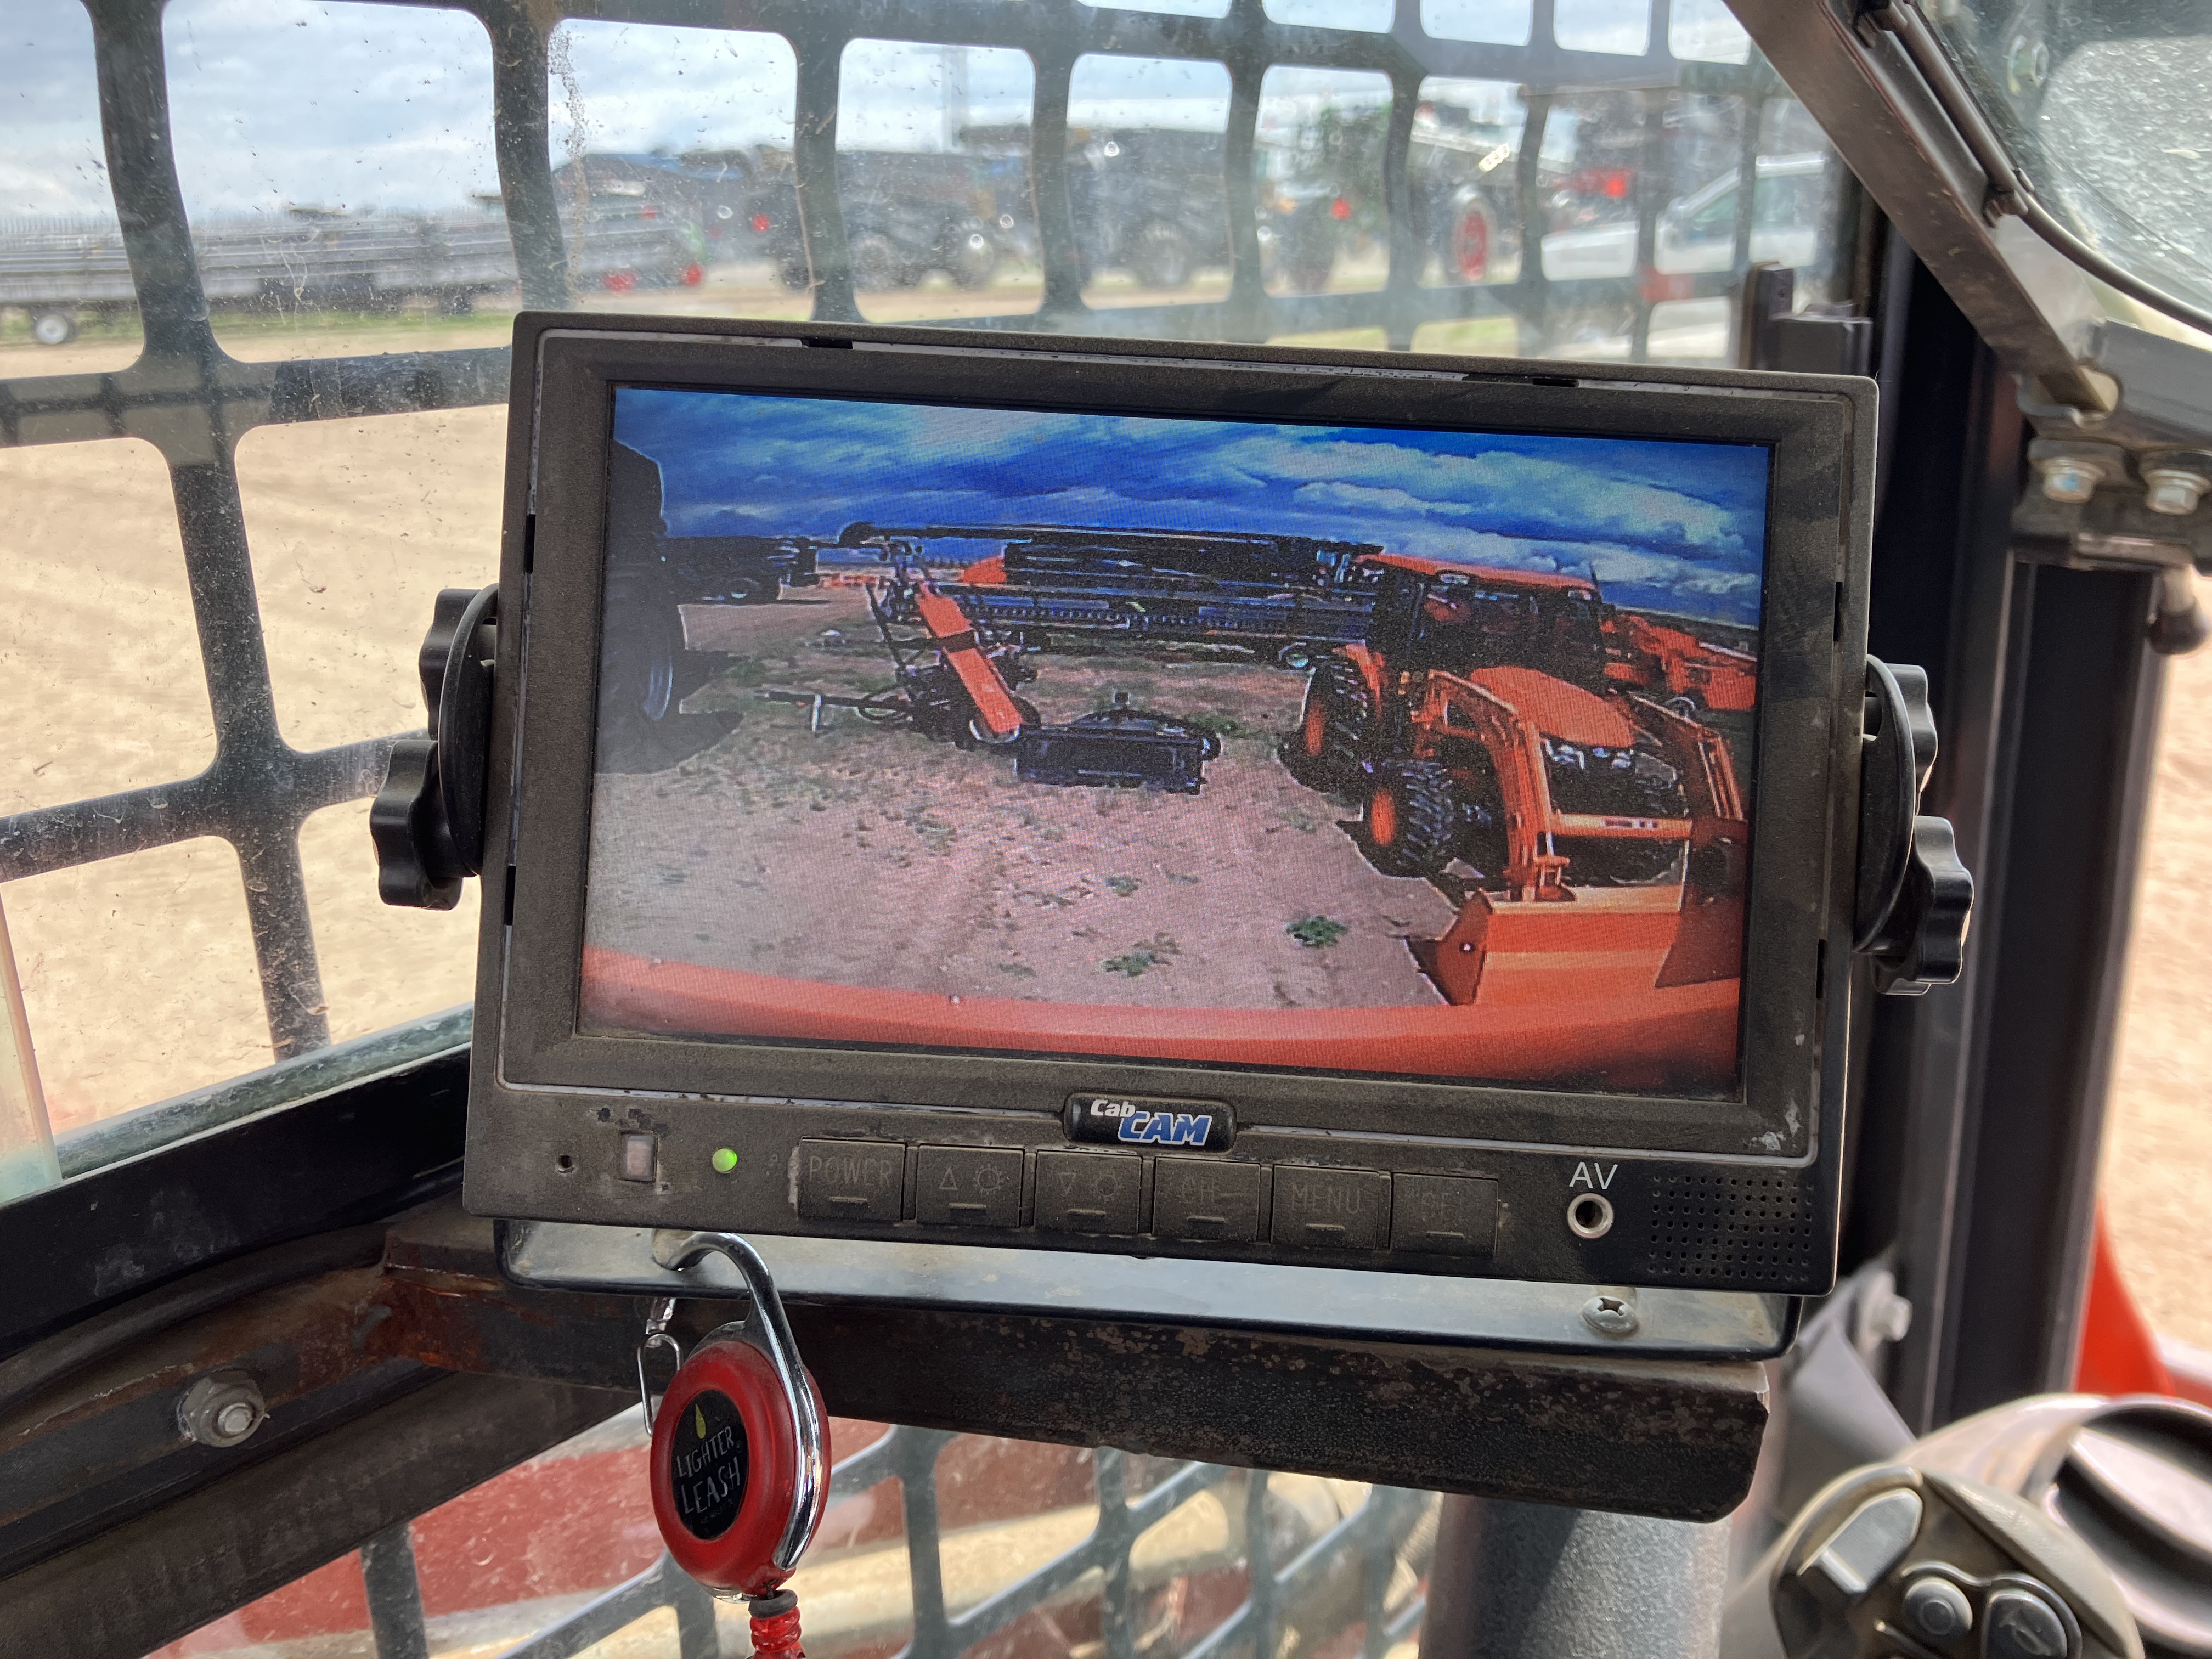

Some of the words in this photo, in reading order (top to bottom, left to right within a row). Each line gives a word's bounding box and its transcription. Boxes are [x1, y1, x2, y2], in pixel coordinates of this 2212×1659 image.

[1090, 1099, 1136, 1118] Cab
[1118, 1111, 1212, 1146] CAM
[809, 1155, 893, 1188] POWER
[1568, 1161, 1618, 1190] AV
[1290, 1181, 1361, 1214] MENU
[676, 1426, 735, 1479] LIGHTER
[680, 1457, 741, 1515] LEASH
